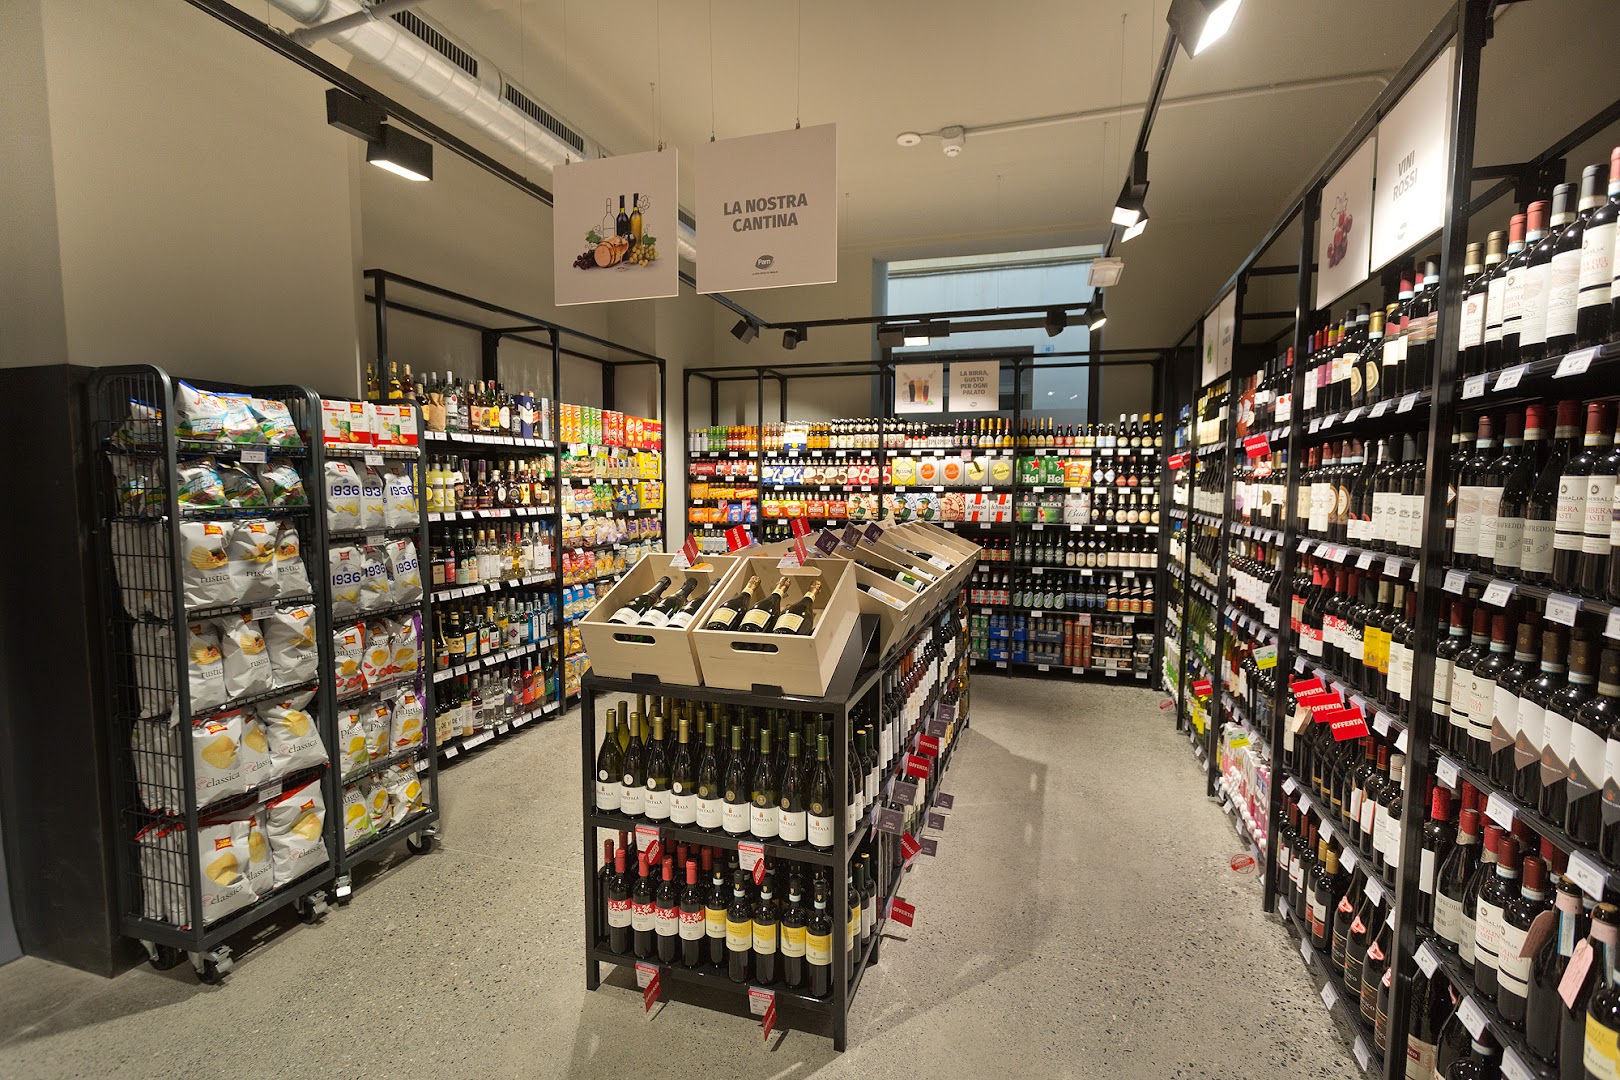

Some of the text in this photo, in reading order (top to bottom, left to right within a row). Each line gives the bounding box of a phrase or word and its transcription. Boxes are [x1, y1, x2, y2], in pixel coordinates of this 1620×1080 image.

[1399, 150, 1416, 177] VINI
[1393, 168, 1418, 202] ROSSI
[723, 193, 808, 216] LA NOSTRA
[732, 212, 799, 233] CANTINA
[757, 257, 772, 266] Pam
[1246, 442, 1268, 451] OFFERTA
[1021, 473, 1039, 484] Hei
[331, 485, 360, 496] 1936
[390, 485, 413, 496] 1936
[1067, 508, 1088, 518] Bud
[332, 559, 418, 586] 1936 1936 1936
[200, 573, 231, 584] rustica
[1295, 687, 1324, 698] OFFERTA
[1312, 703, 1342, 713] OFFERTA
[1331, 718, 1364, 730] OFFERTA
[288, 739, 318, 755] classica
[919, 740, 938, 751] OFFERTA
[908, 761, 928, 772] OFFERTA
[206, 771, 241, 789] classica
[210, 883, 245, 905] classica
[892, 907, 914, 919] OFFERTA
